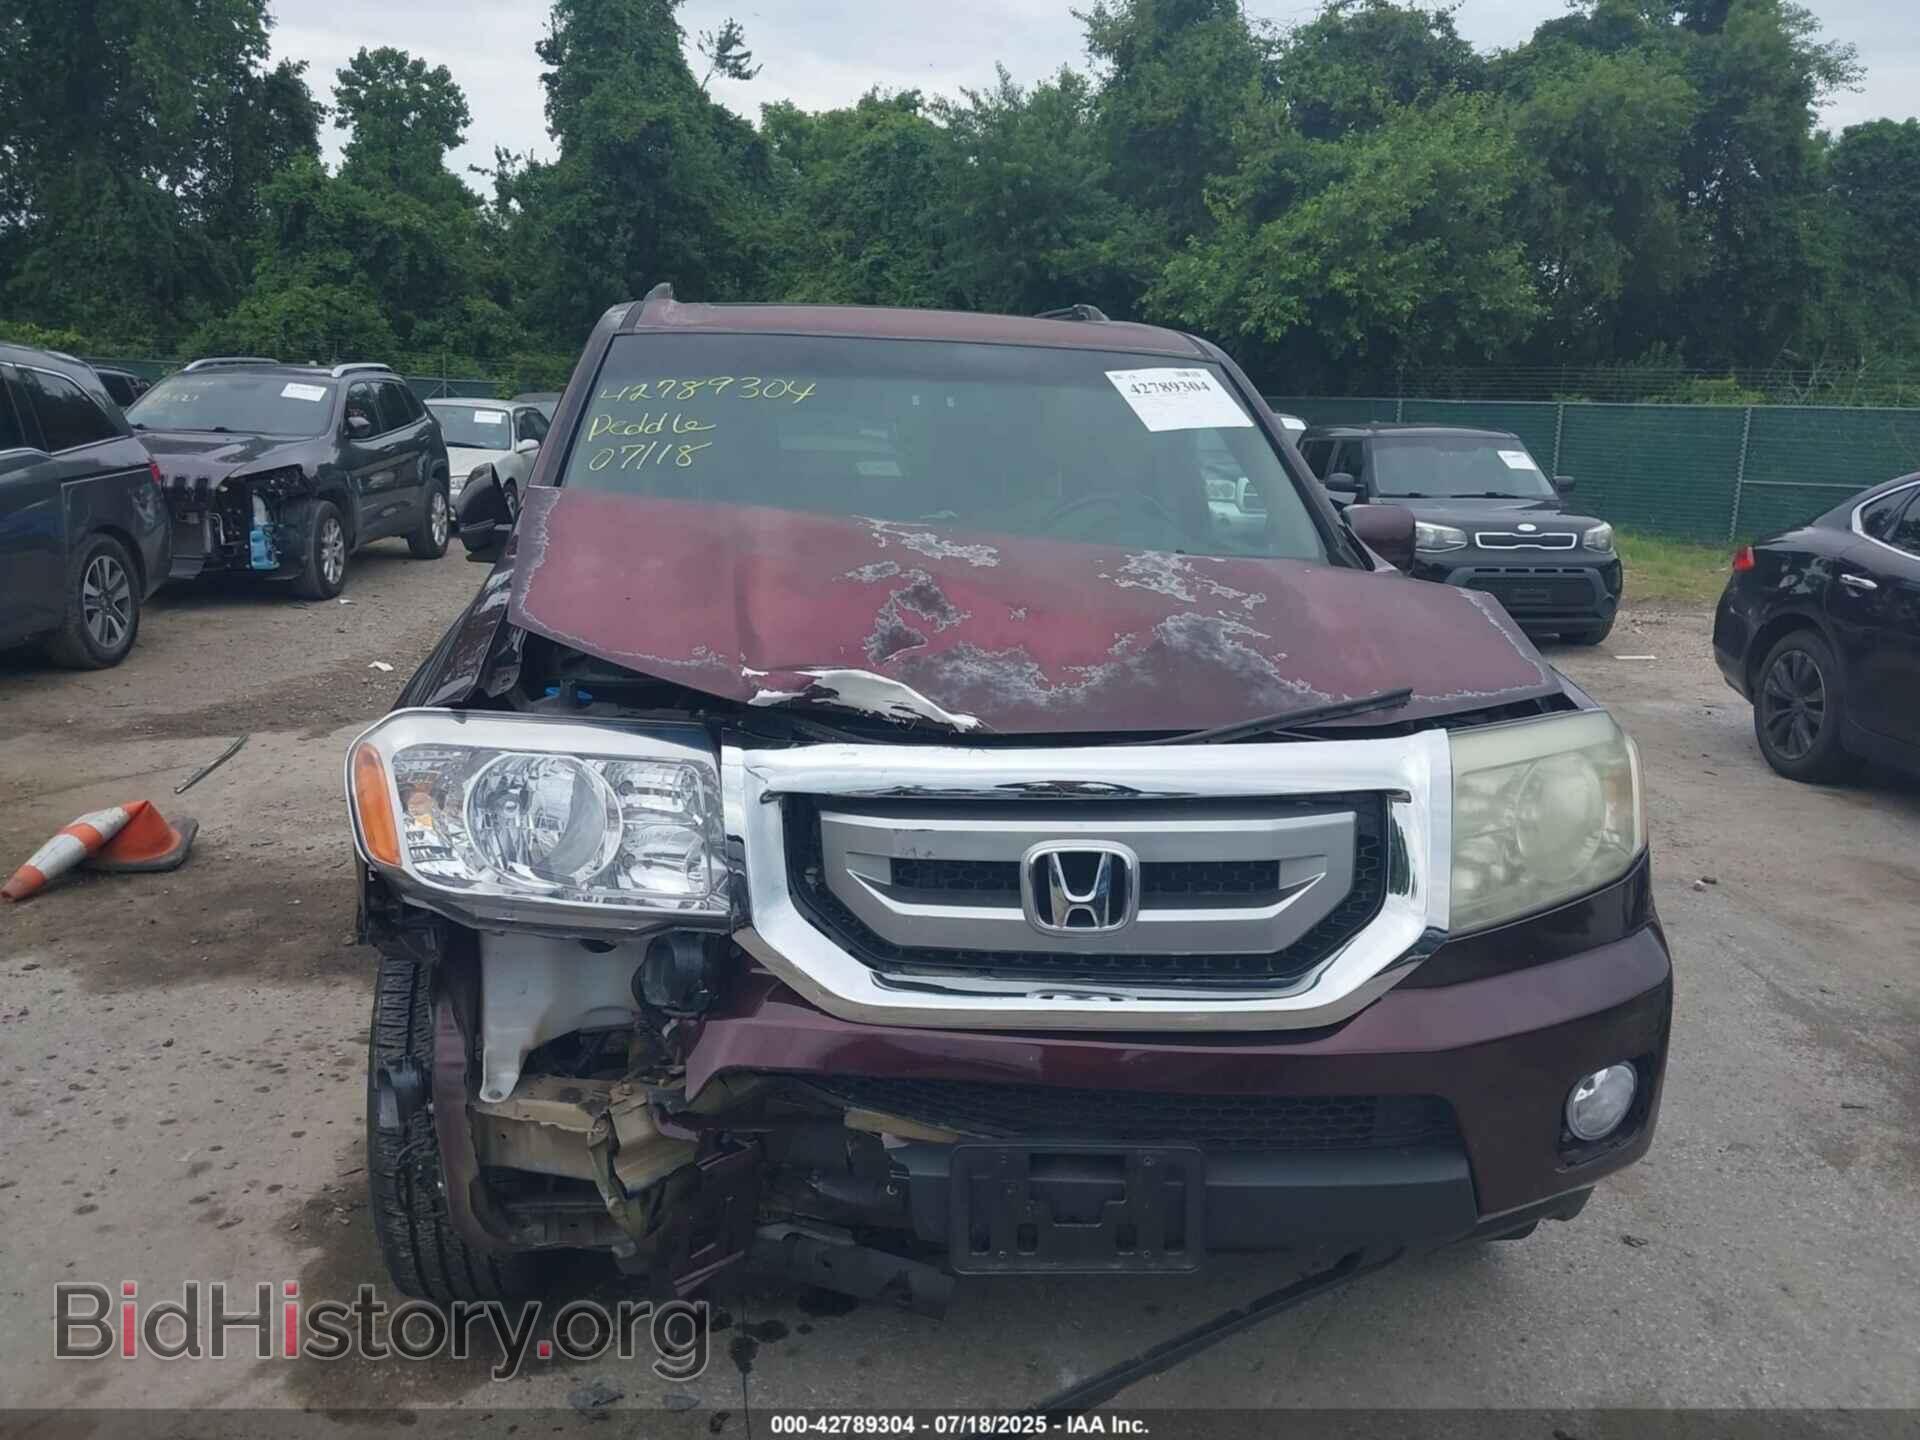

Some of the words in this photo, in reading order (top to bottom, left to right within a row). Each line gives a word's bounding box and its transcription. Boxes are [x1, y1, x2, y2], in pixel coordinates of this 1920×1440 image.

[600, 377, 816, 404] 42789304
[1130, 381, 1211, 394] 42789304
[589, 441, 713, 470] 07/18
